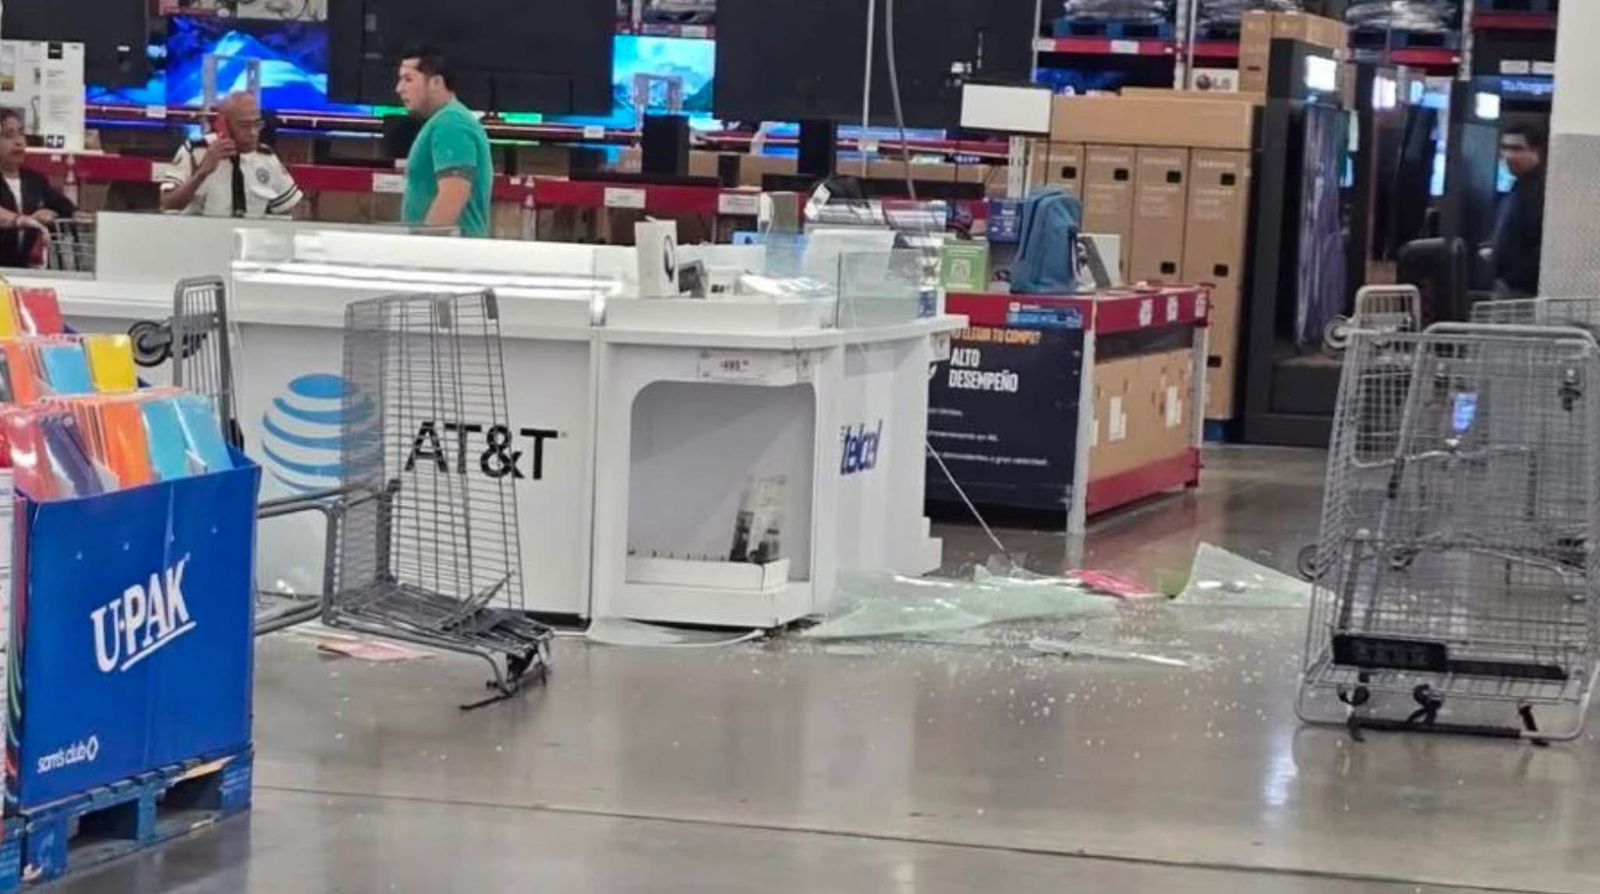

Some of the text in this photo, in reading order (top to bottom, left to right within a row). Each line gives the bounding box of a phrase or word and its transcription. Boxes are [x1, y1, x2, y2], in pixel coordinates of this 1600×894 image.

[951, 349, 980, 367] ALTO
[949, 371, 1018, 392] DESEMPEÑO
[405, 421, 559, 481] AT&T
[65, 740, 86, 764] club
